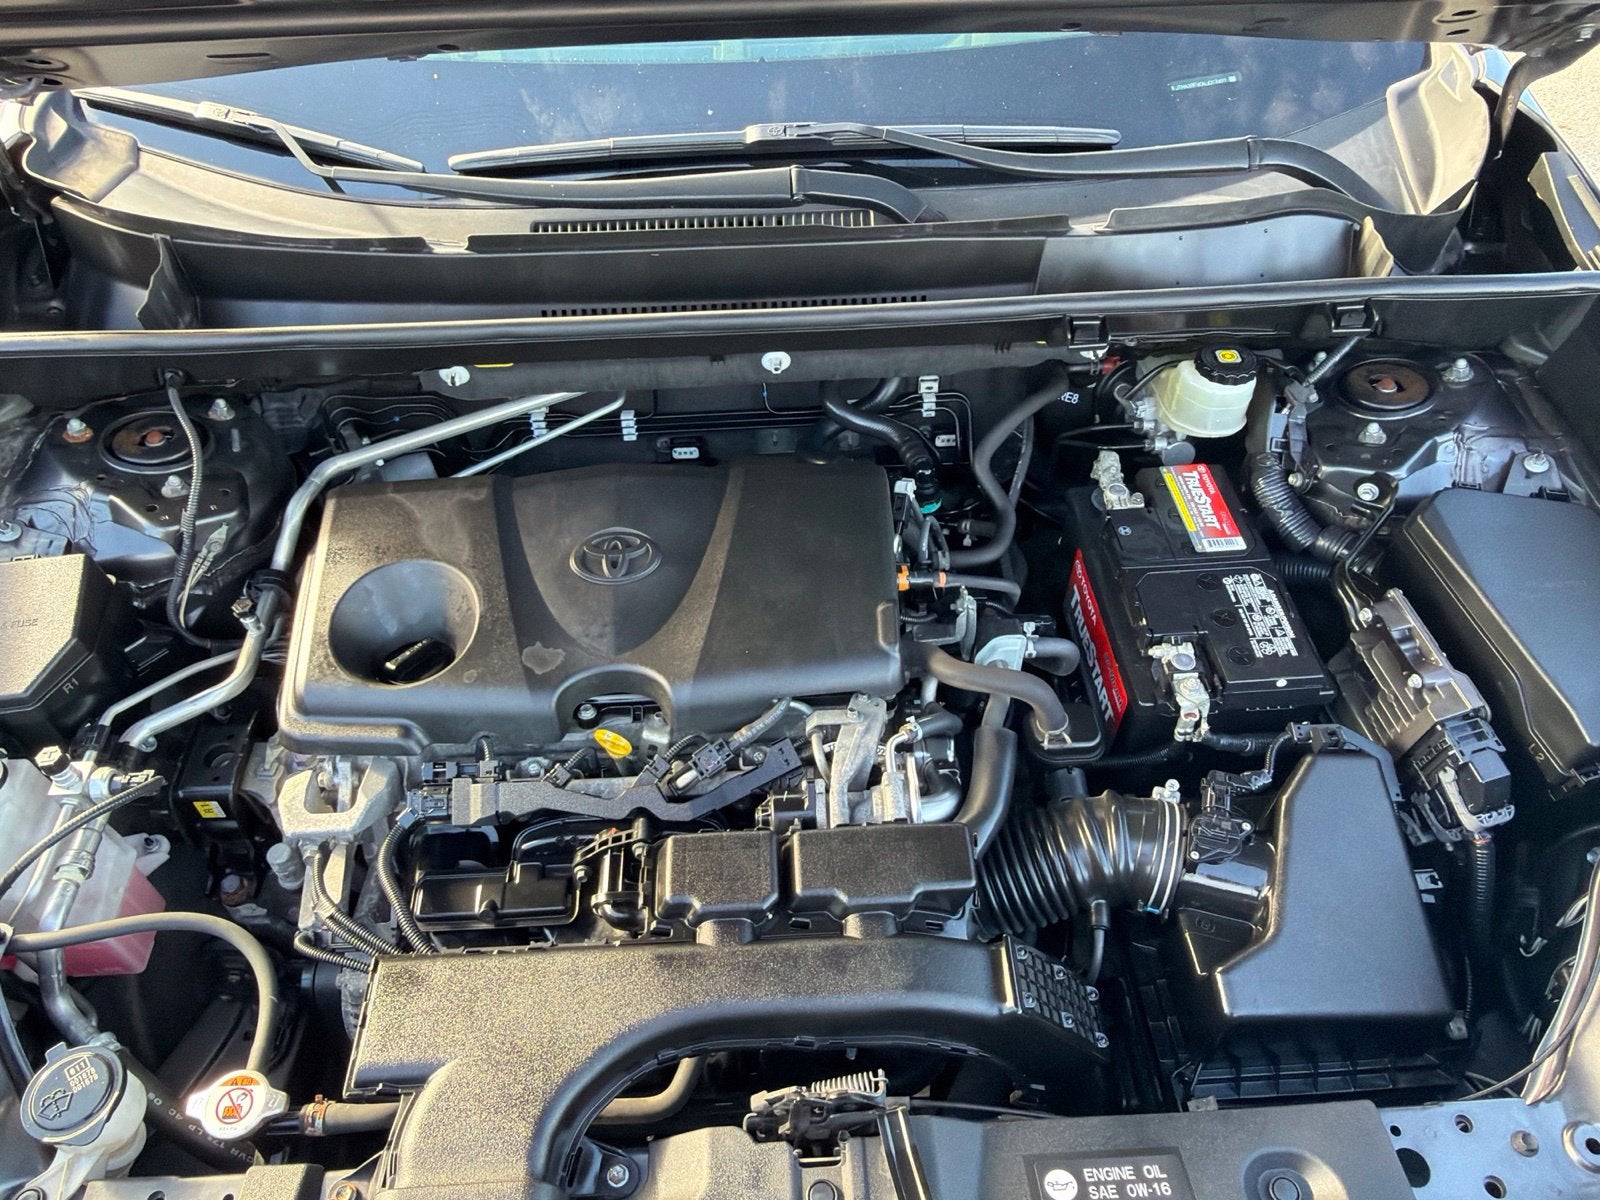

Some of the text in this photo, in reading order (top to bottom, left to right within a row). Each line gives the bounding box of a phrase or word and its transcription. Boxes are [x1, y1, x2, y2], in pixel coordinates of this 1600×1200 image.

[1201, 473, 1216, 495] TOYOTA
[1079, 575, 1097, 627] TOYOTA
[11, 617, 39, 627] FUSE
[62, 677, 79, 694] R1
[1083, 1164, 1168, 1182] ENGINE OIL
[1089, 1182, 1172, 1200] SAE 0W-16
